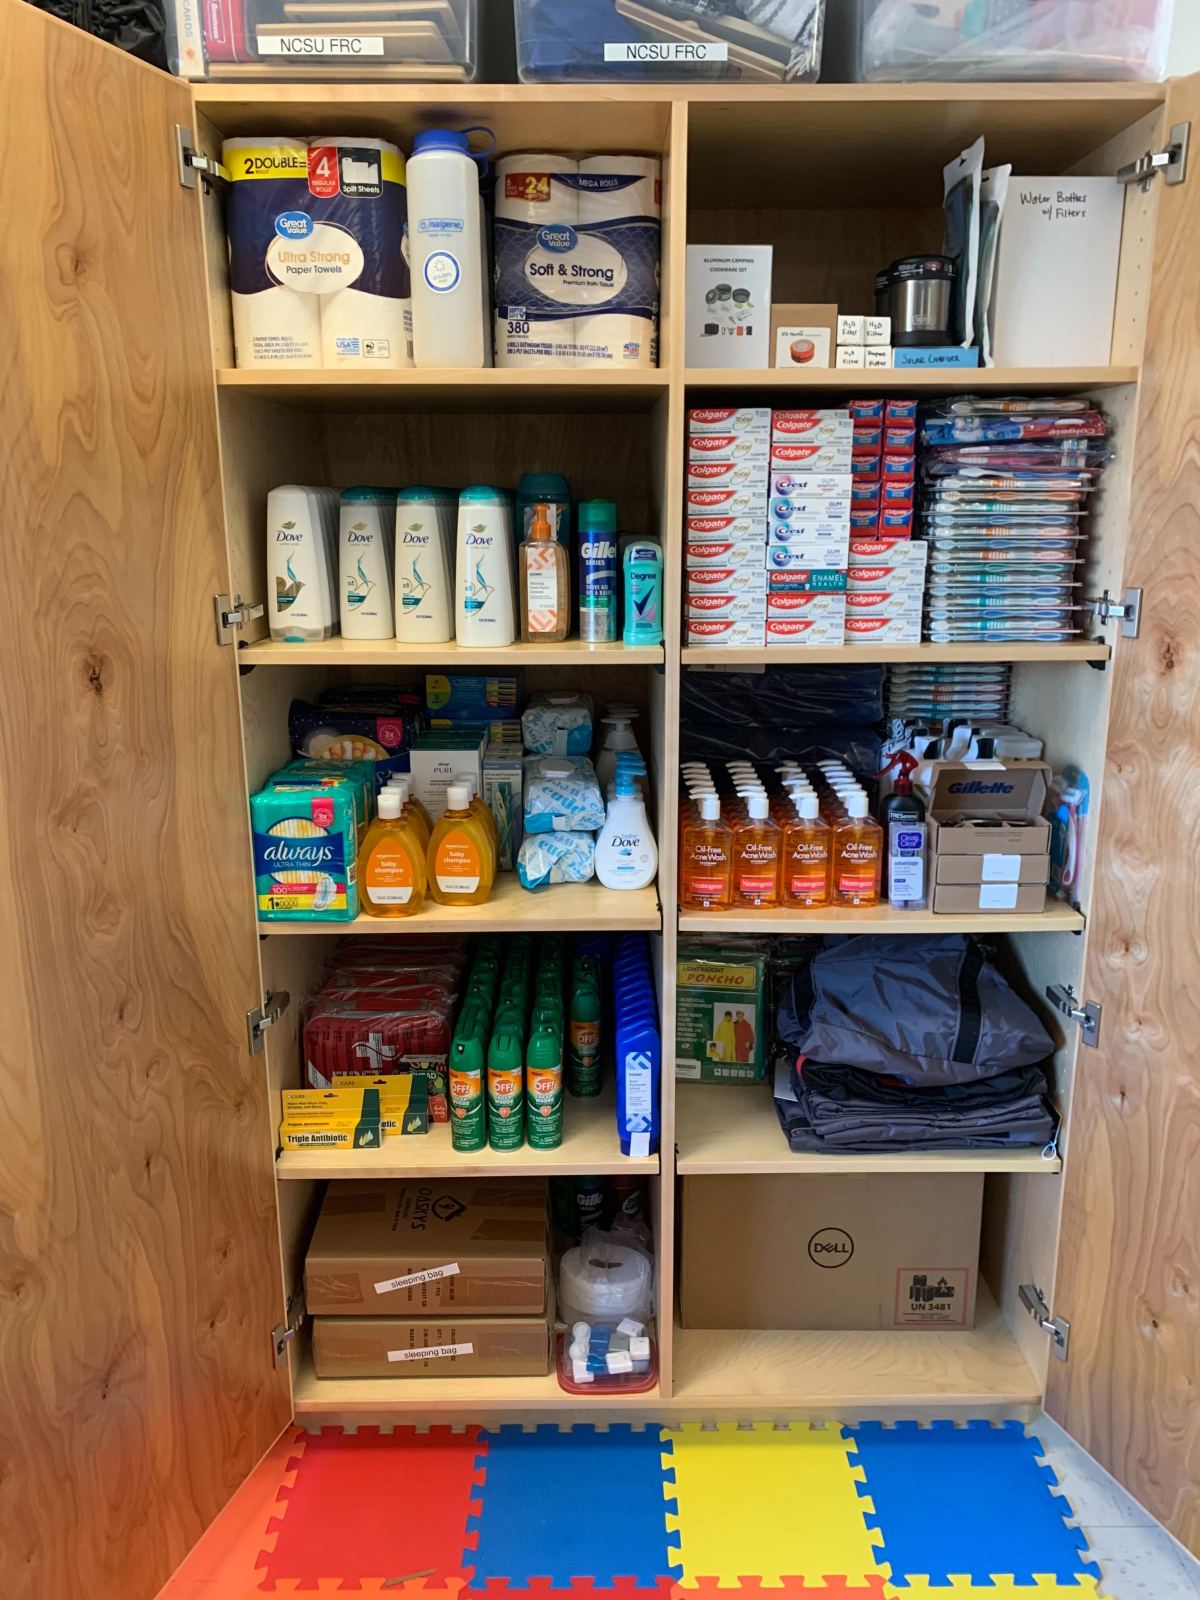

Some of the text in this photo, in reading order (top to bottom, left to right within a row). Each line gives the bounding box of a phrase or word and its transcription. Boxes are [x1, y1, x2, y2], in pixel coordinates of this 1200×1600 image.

[280, 38, 362, 54] NCSU FRC
[626, 44, 706, 60] NCSU FRC
[244, 157, 298, 175] 2 DOUBLE
[315, 156, 331, 177] 4
[525, 176, 549, 195] 24
[578, 178, 618, 188] MEGA ROLLS
[342, 185, 380, 194] Split Sheets
[1019, 191, 1087, 205] Water Bottles
[1056, 208, 1087, 219] Filters
[280, 217, 308, 228] Great
[286, 226, 309, 235] Value
[541, 230, 570, 242] Great
[548, 239, 571, 247] Value
[278, 251, 350, 266] Ultra Strong
[286, 264, 342, 276] Paper Towels
[529, 263, 614, 282] Soft & Strong
[562, 279, 586, 287] Premium
[507, 321, 530, 334] 380
[692, 410, 729, 419] Colgate
[776, 420, 813, 429] Colgate
[692, 438, 728, 447] Colgate
[775, 447, 812, 456] Colgate
[691, 465, 728, 474] Colgate
[779, 481, 808, 489] Crest
[690, 493, 727, 502] Colgate
[777, 504, 807, 512] Crest
[690, 519, 727, 528] Colgate
[276, 531, 303, 542] Dove
[347, 531, 374, 543] Dove
[402, 531, 430, 544] Dove
[465, 533, 493, 546] Dove
[689, 545, 726, 555] Colgate
[852, 543, 889, 552] Colgate
[630, 571, 657, 581] Degree
[691, 571, 728, 580] Colgate
[771, 573, 808, 582] Colgate
[811, 574, 845, 582] ENAMEL
[849, 569, 886, 578] Colgate
[691, 597, 728, 606] Colgate
[771, 597, 807, 607] Colgate
[847, 595, 883, 604] Colgate
[691, 622, 727, 632] Colgate
[769, 622, 806, 632] Colgate
[846, 620, 882, 629] Colgate
[947, 782, 1016, 795] Gillette
[611, 834, 640, 847] Dove
[695, 845, 722, 854] Oil-Free
[745, 844, 773, 852] Oil-Free
[797, 844, 824, 852] Oil-Free
[846, 843, 873, 851] Oil-Free
[263, 840, 336, 867] always
[690, 852, 727, 861] Acne Wash
[740, 851, 777, 859] Acne Wash
[792, 851, 828, 859] Acne Wash
[841, 850, 859, 858] Acne
[373, 867, 404, 875] shampoo
[687, 973, 745, 985] PONCHO
[579, 1033, 597, 1044] OFF!
[451, 1084, 470, 1094] OFF!
[495, 1083, 515, 1092] OFF!
[534, 1082, 555, 1091] OFF!
[287, 1134, 348, 1143] Triple Antibiotic
[814, 1242, 850, 1253] DELL
[390, 1269, 444, 1289] sleeping bag
[911, 1303, 952, 1311] UN 3481
[403, 1347, 457, 1359] sleeping bag
